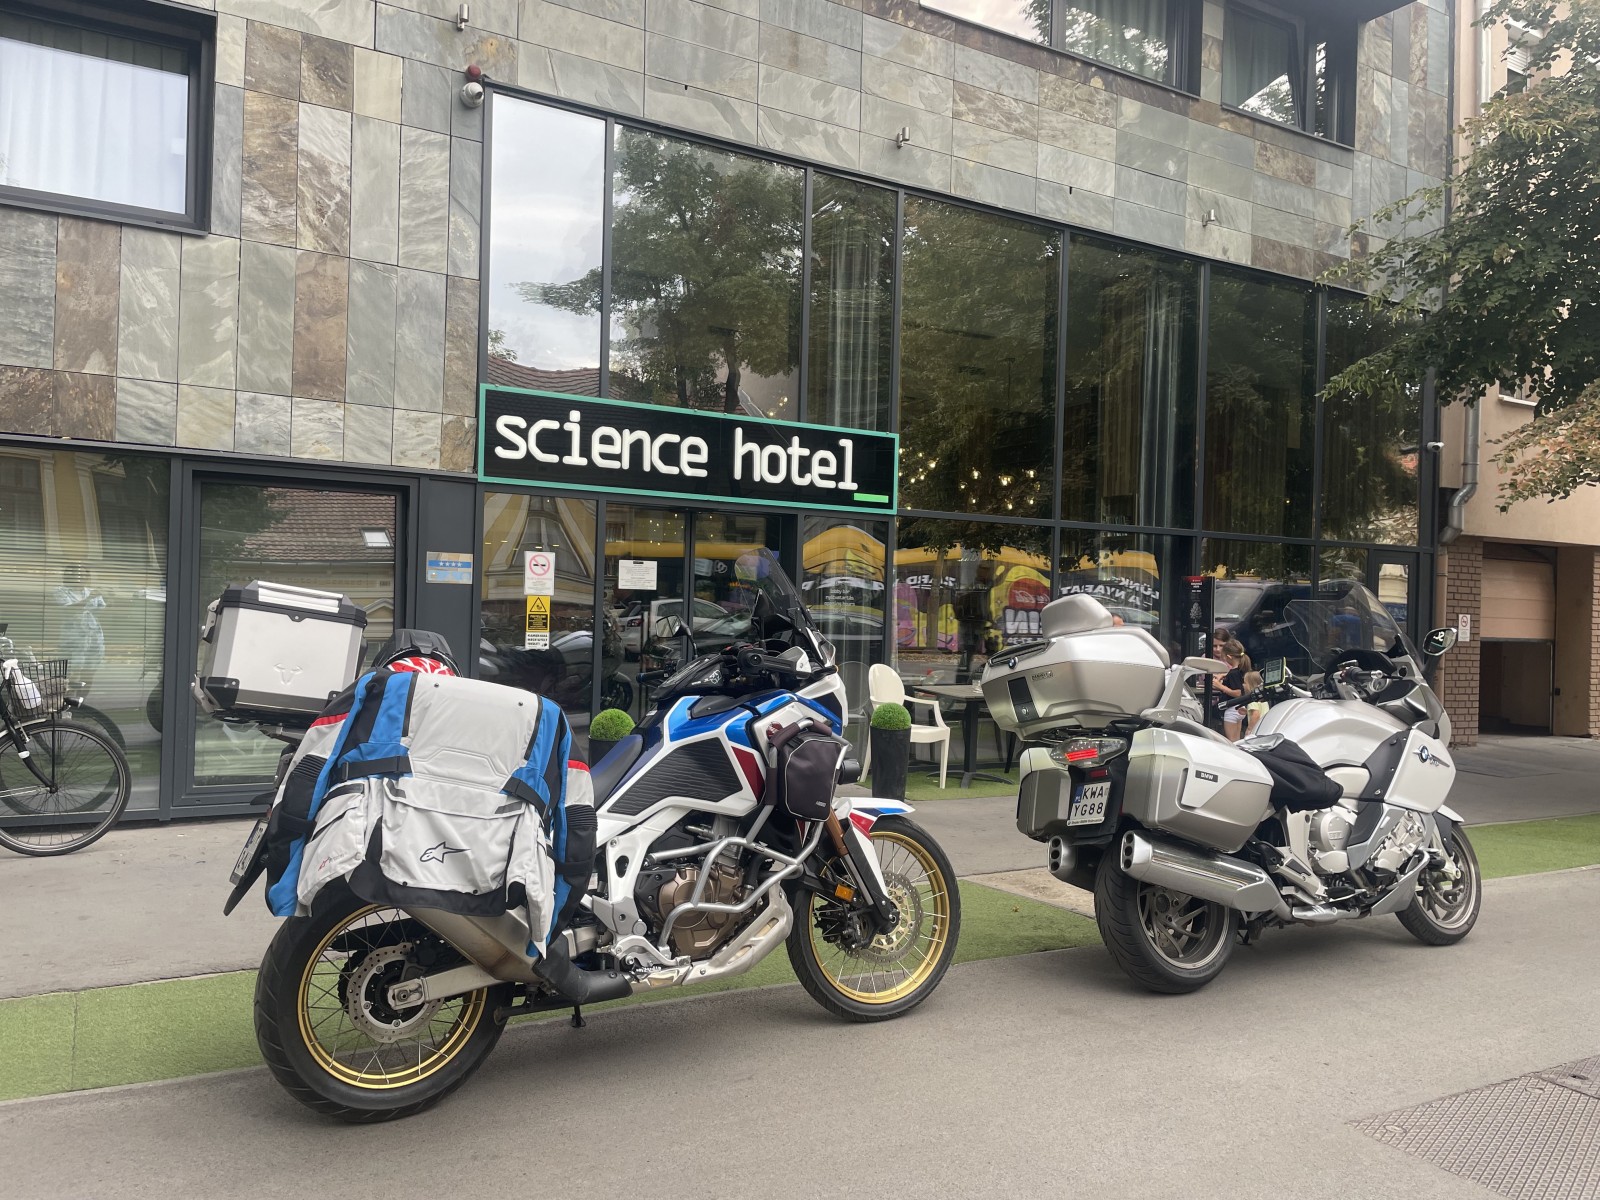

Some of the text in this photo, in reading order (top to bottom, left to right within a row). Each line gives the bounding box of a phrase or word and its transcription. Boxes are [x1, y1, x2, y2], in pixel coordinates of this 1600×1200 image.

[494, 410, 859, 490] science hotel
[1200, 772, 1214, 780] BMW
[1082, 786, 1104, 800] KWA
[1074, 802, 1104, 817] YG88
